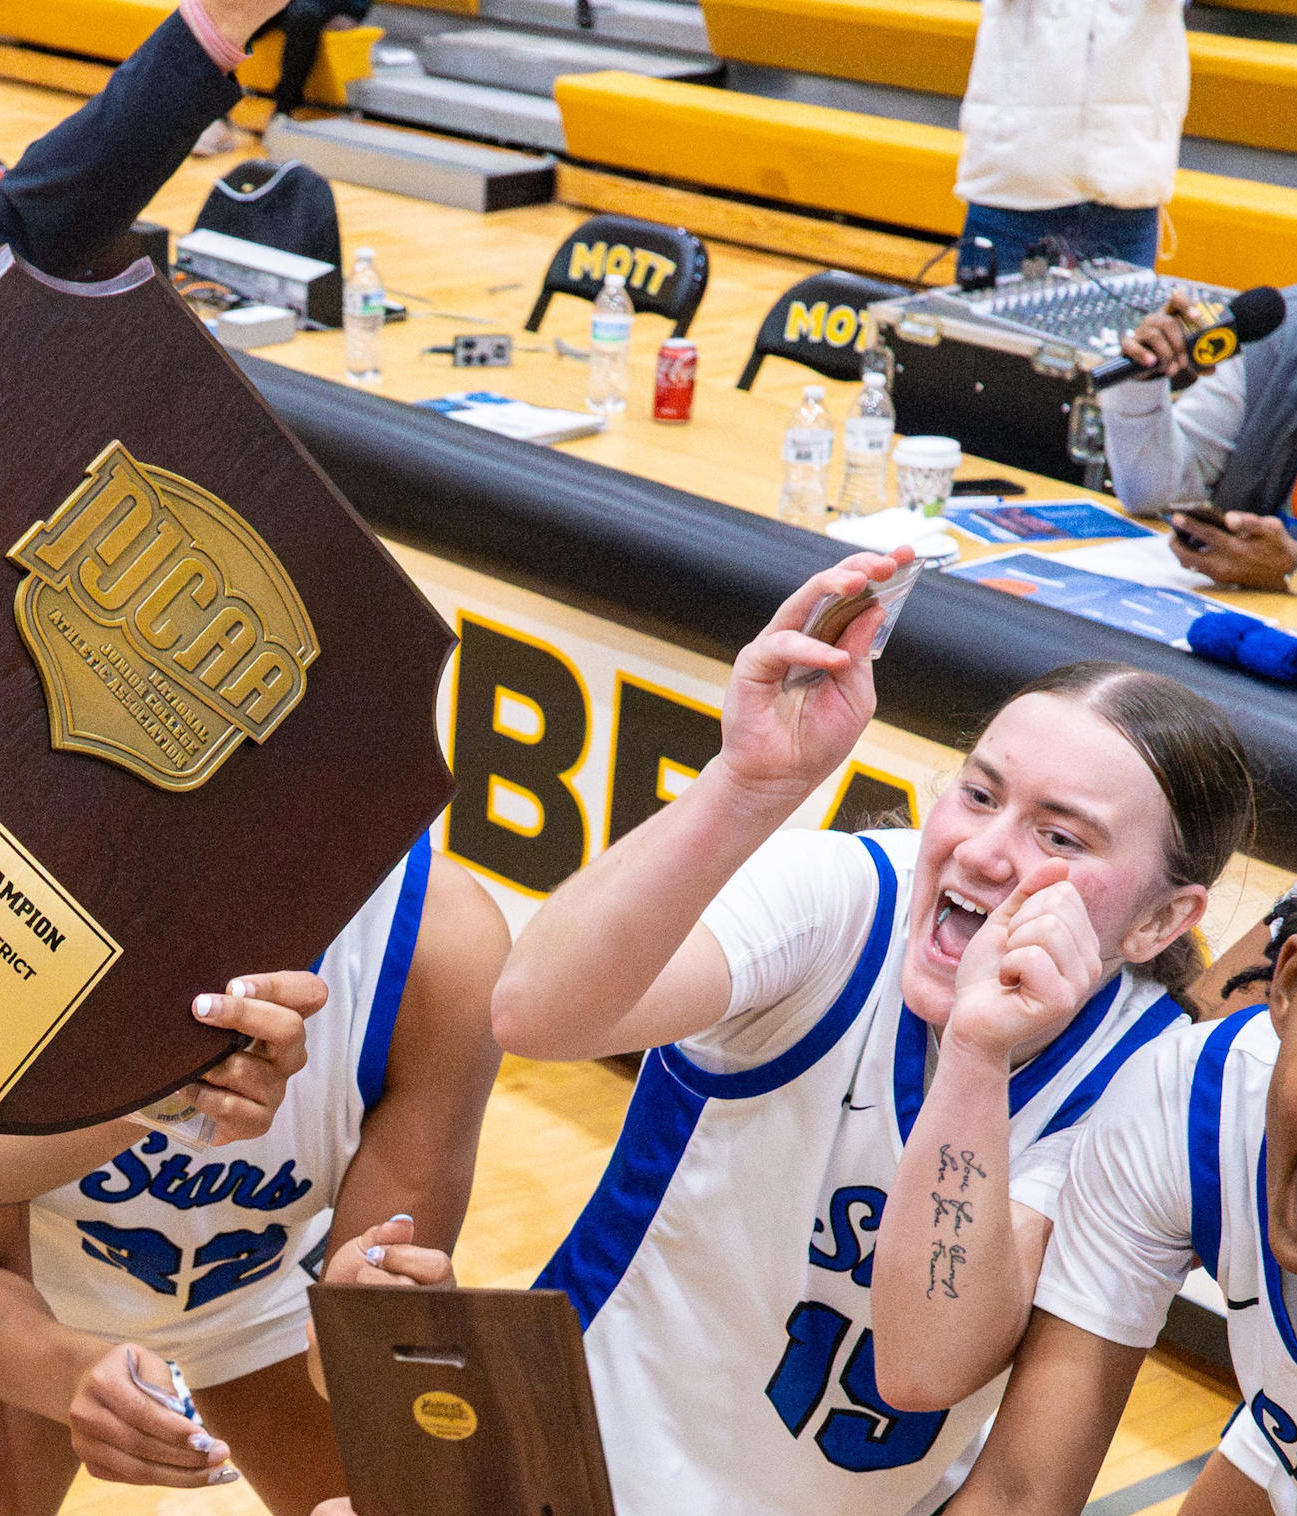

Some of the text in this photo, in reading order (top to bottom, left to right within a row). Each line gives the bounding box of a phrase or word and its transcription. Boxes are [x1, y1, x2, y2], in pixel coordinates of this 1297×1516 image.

[568, 240, 677, 295] MOTT
[34, 464, 295, 725] NJCAA
[48, 608, 191, 769] ATHLETIC ASSOCIATION
[100, 642, 200, 756] JUNIOR COLLEGE
[148, 670, 208, 744] NATIONAL
[79, 1130, 313, 1211] Stars
